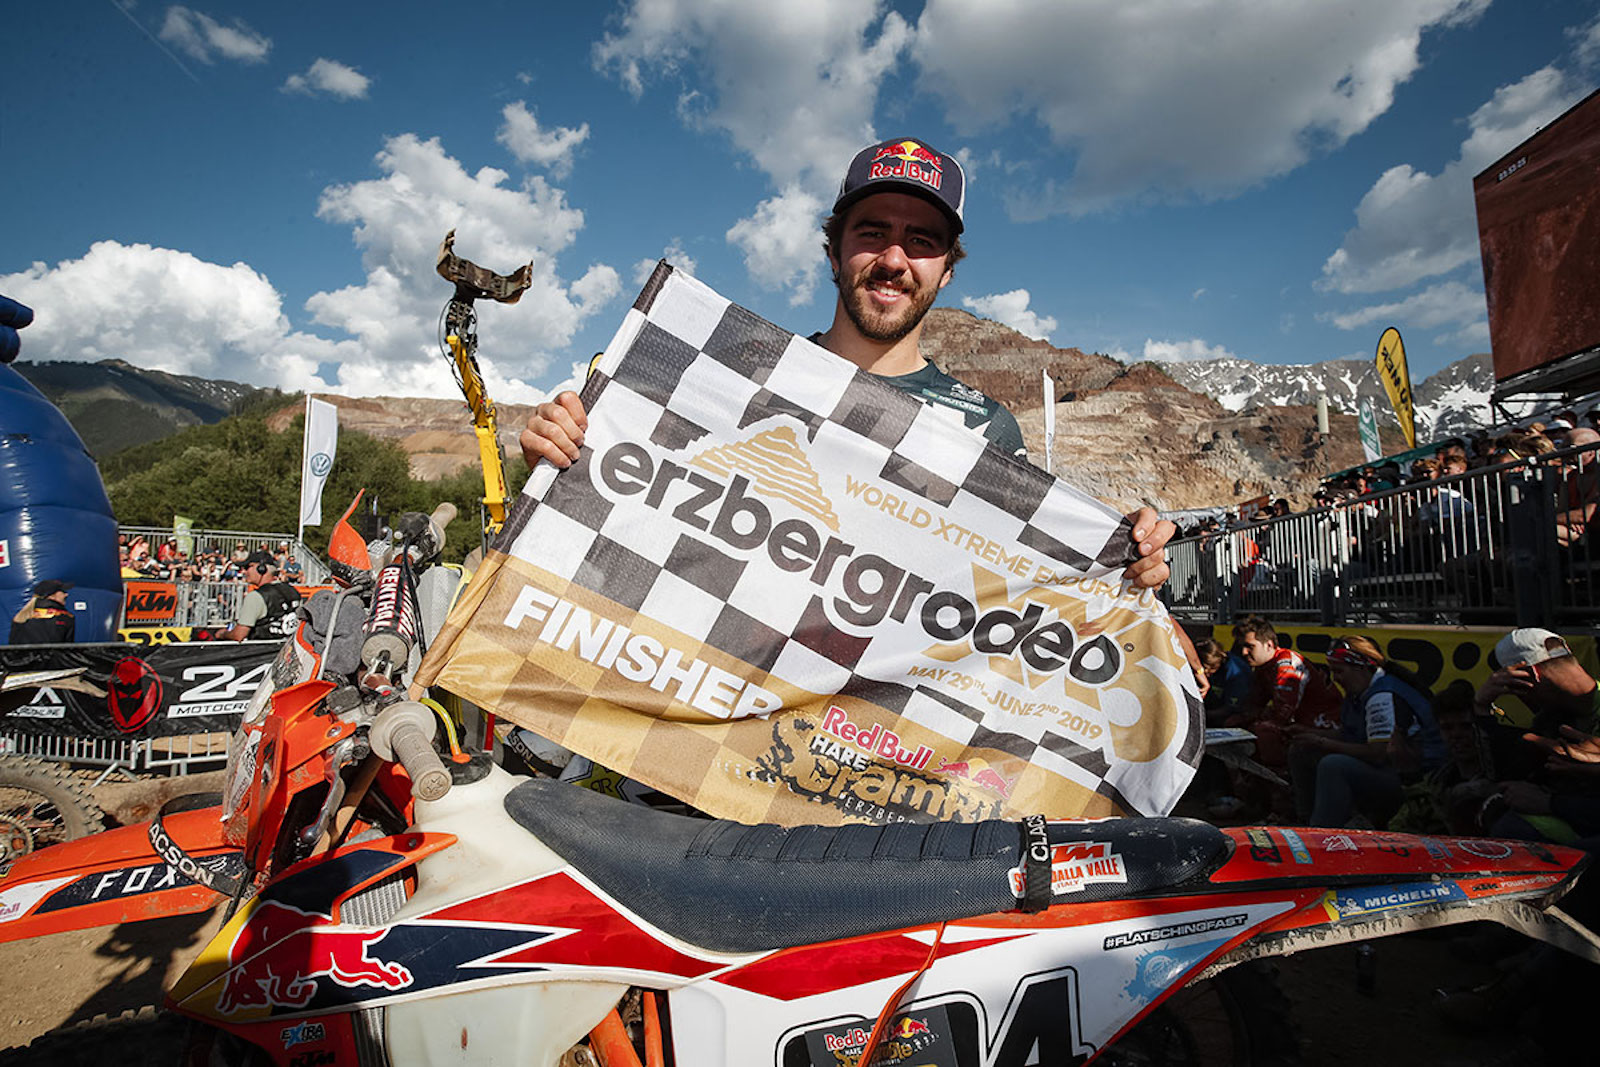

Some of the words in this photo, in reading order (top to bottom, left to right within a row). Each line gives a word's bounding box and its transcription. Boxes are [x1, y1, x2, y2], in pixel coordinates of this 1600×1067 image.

[868, 160, 906, 179] Red
[907, 162, 942, 190] Bull
[846, 475, 931, 529] WORLD
[933, 517, 1033, 577] XTREME
[601, 442, 1120, 684] erzbergrodeo
[128, 591, 175, 611] KTM
[371, 567, 401, 632] RENTHAL
[907, 666, 949, 683] MAY
[1056, 711, 1103, 740] 2019
[811, 734, 869, 772] HARE
[821, 705, 880, 751] Red
[877, 728, 934, 771] Bull
[845, 797, 916, 825] ERZBER
[1050, 843, 1105, 864] TM
[1087, 857, 1120, 877] VALLE
[91, 865, 178, 899] FOX
[1057, 880, 1080, 889] ITALY
[1364, 885, 1450, 908] MICHELIN
[1105, 915, 1247, 948] #FLATSCHINGFAST
[825, 1030, 853, 1051] Red
